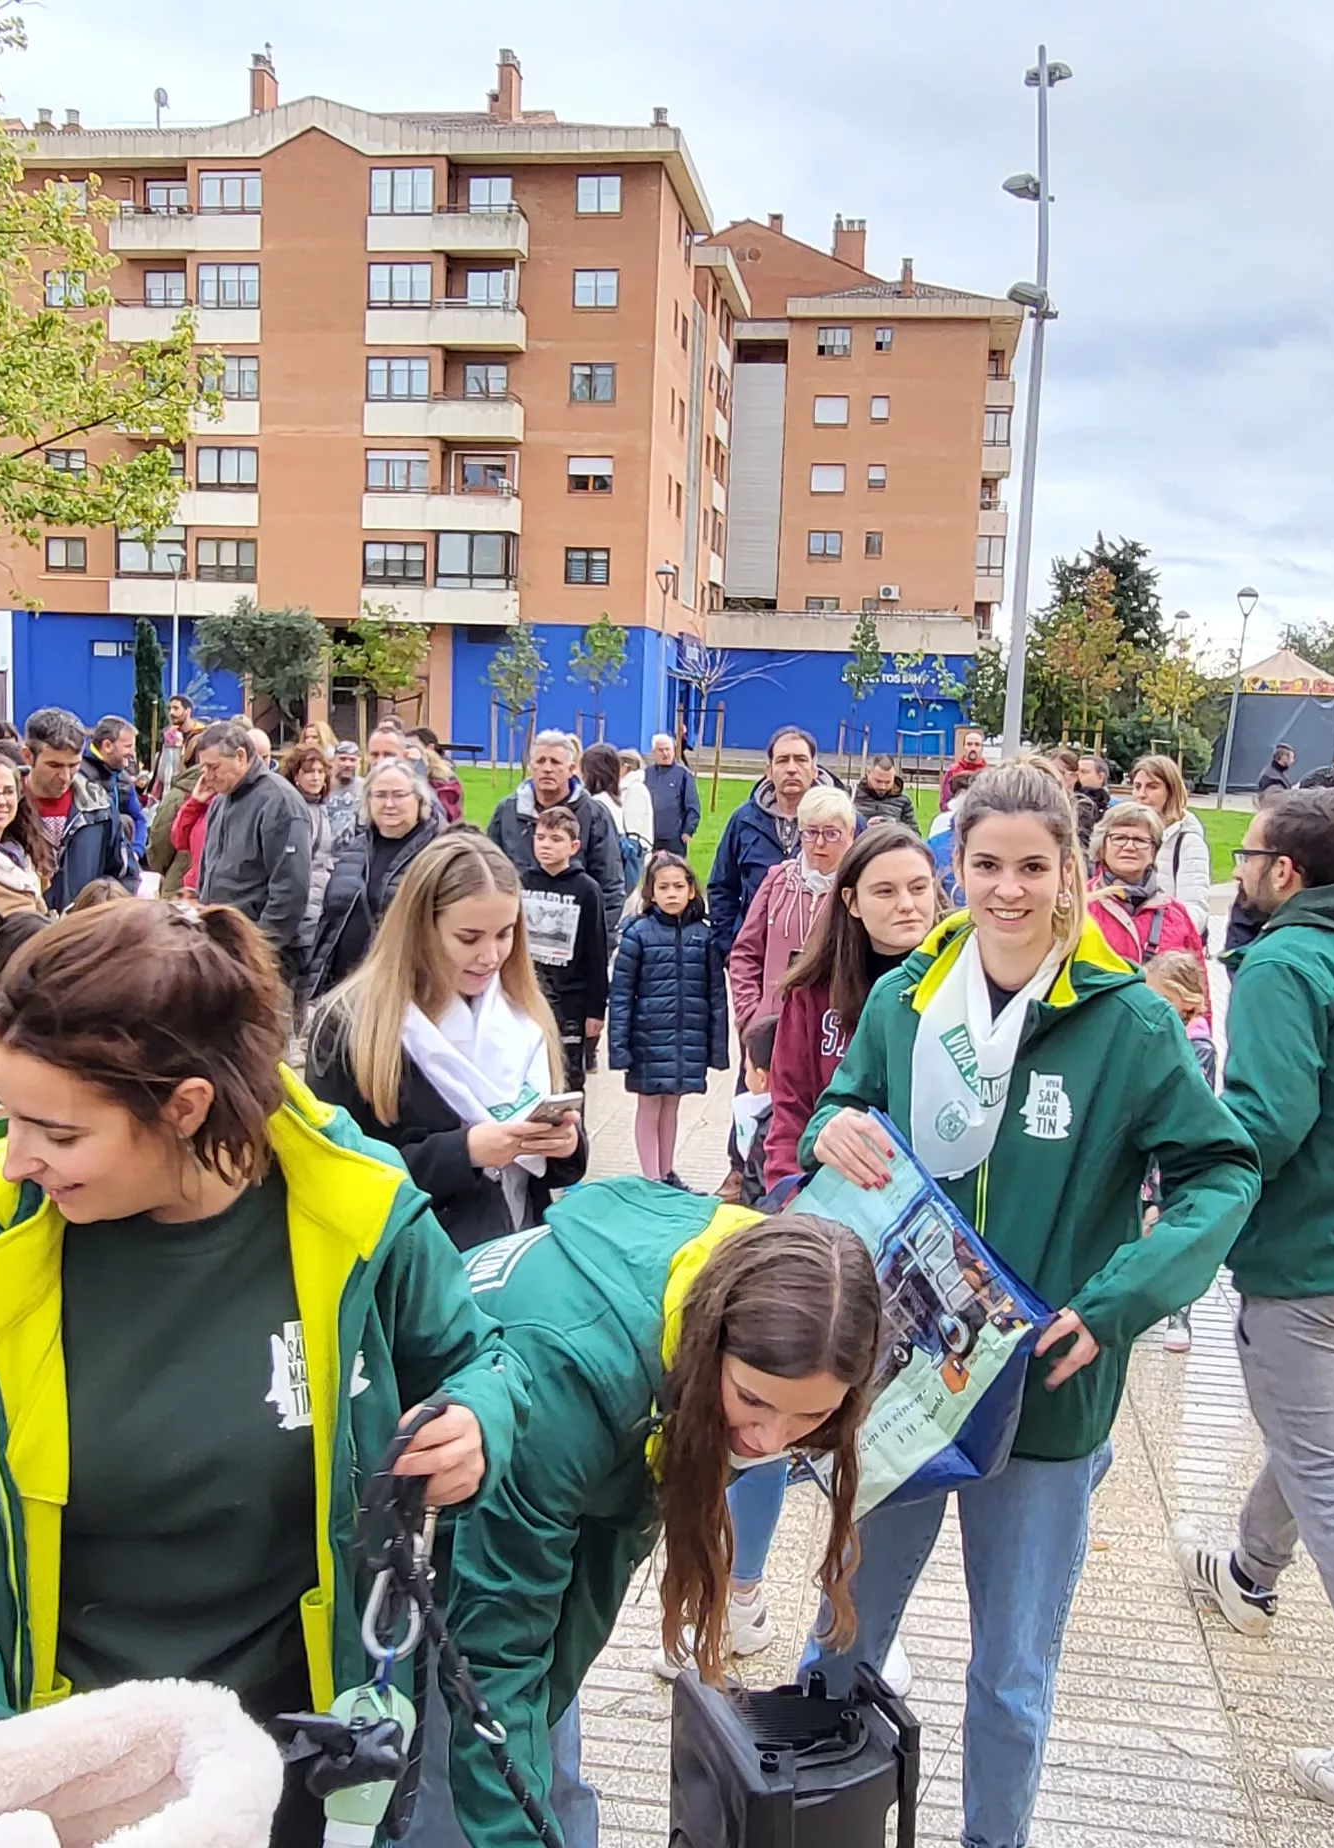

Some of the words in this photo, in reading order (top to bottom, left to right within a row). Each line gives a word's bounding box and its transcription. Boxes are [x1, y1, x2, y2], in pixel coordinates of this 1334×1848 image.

[945, 1028, 977, 1073] VIVA
[1038, 1089, 1060, 1104] SAN
[1036, 1104, 1058, 1117] MAR
[1035, 1116, 1057, 1135] TIN
[287, 1340, 305, 1363] SA
